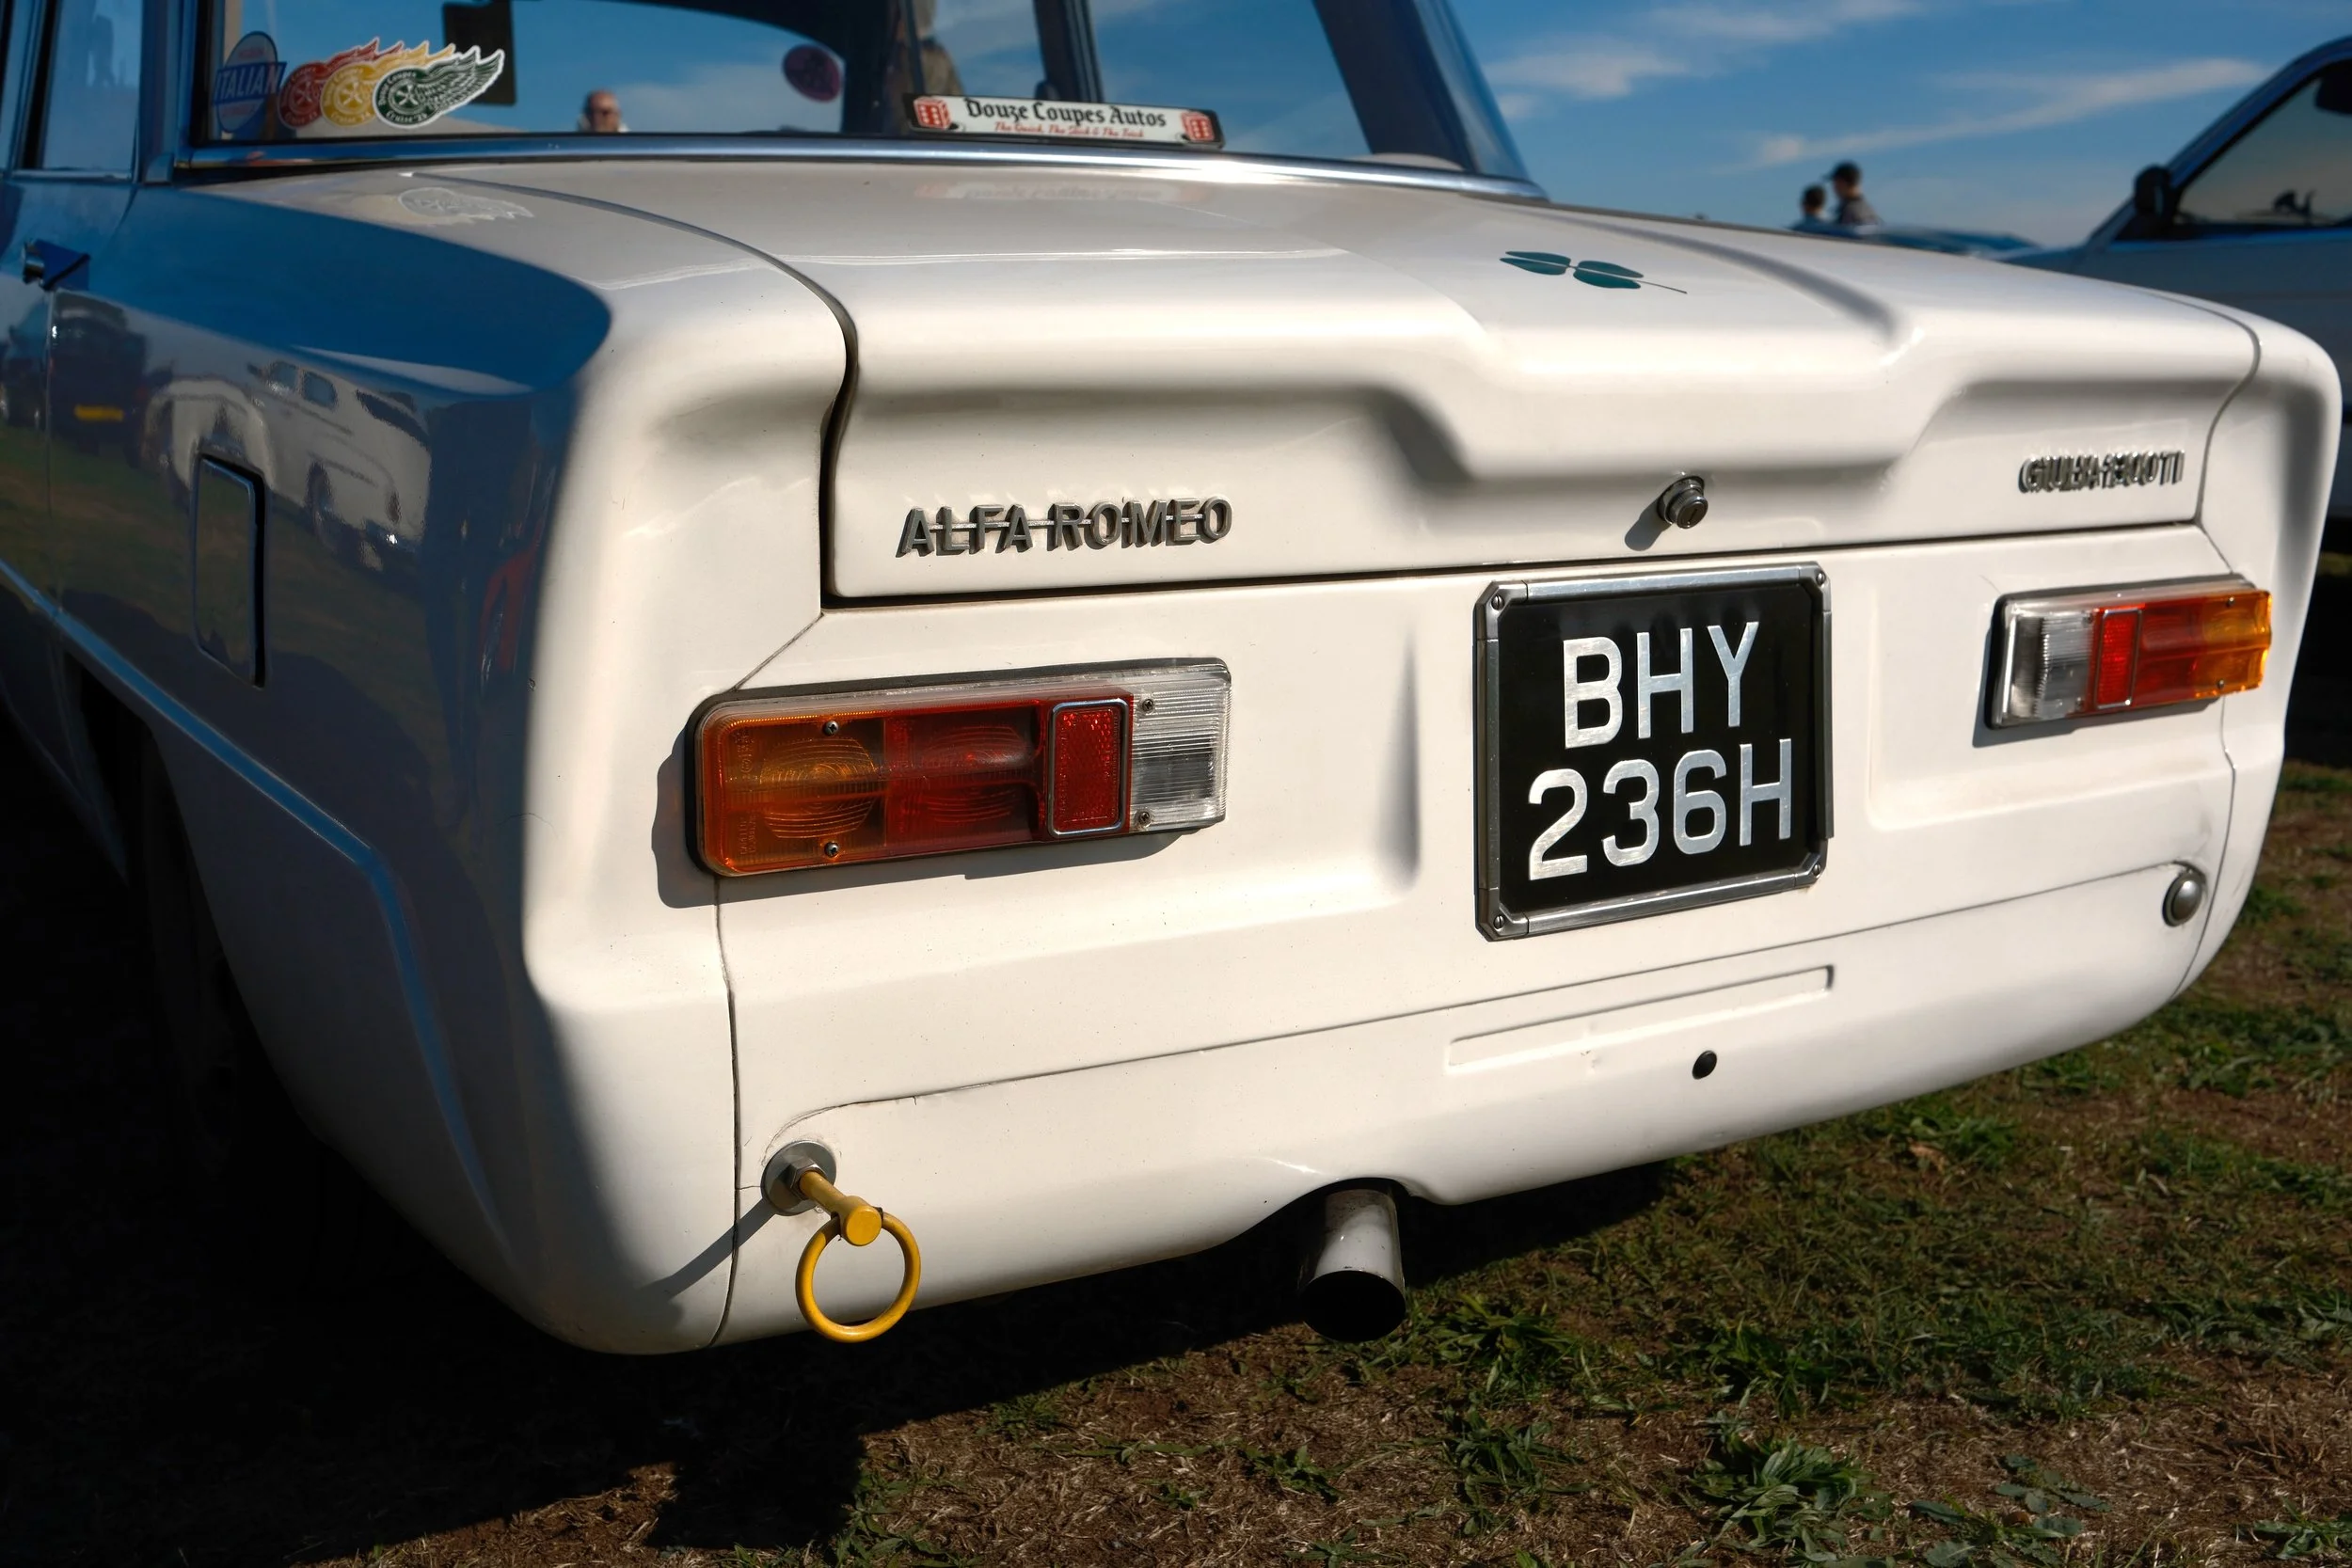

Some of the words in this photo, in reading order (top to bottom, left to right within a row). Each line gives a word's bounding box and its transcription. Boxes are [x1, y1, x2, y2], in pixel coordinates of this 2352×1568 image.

[214, 64, 283, 102] ITALIAN
[964, 98, 1028, 124] Douze
[1034, 102, 1105, 126] Coupes
[1109, 104, 1167, 128] Autos
[994, 121, 1011, 133] The
[1048, 123, 1066, 135] The
[1103, 127, 1120, 137] The
[896, 503, 1034, 558] ALFA
[1046, 495, 1232, 552] ROMEO
[1563, 621, 1759, 750] BHY
[1528, 737, 1792, 881] 236H
